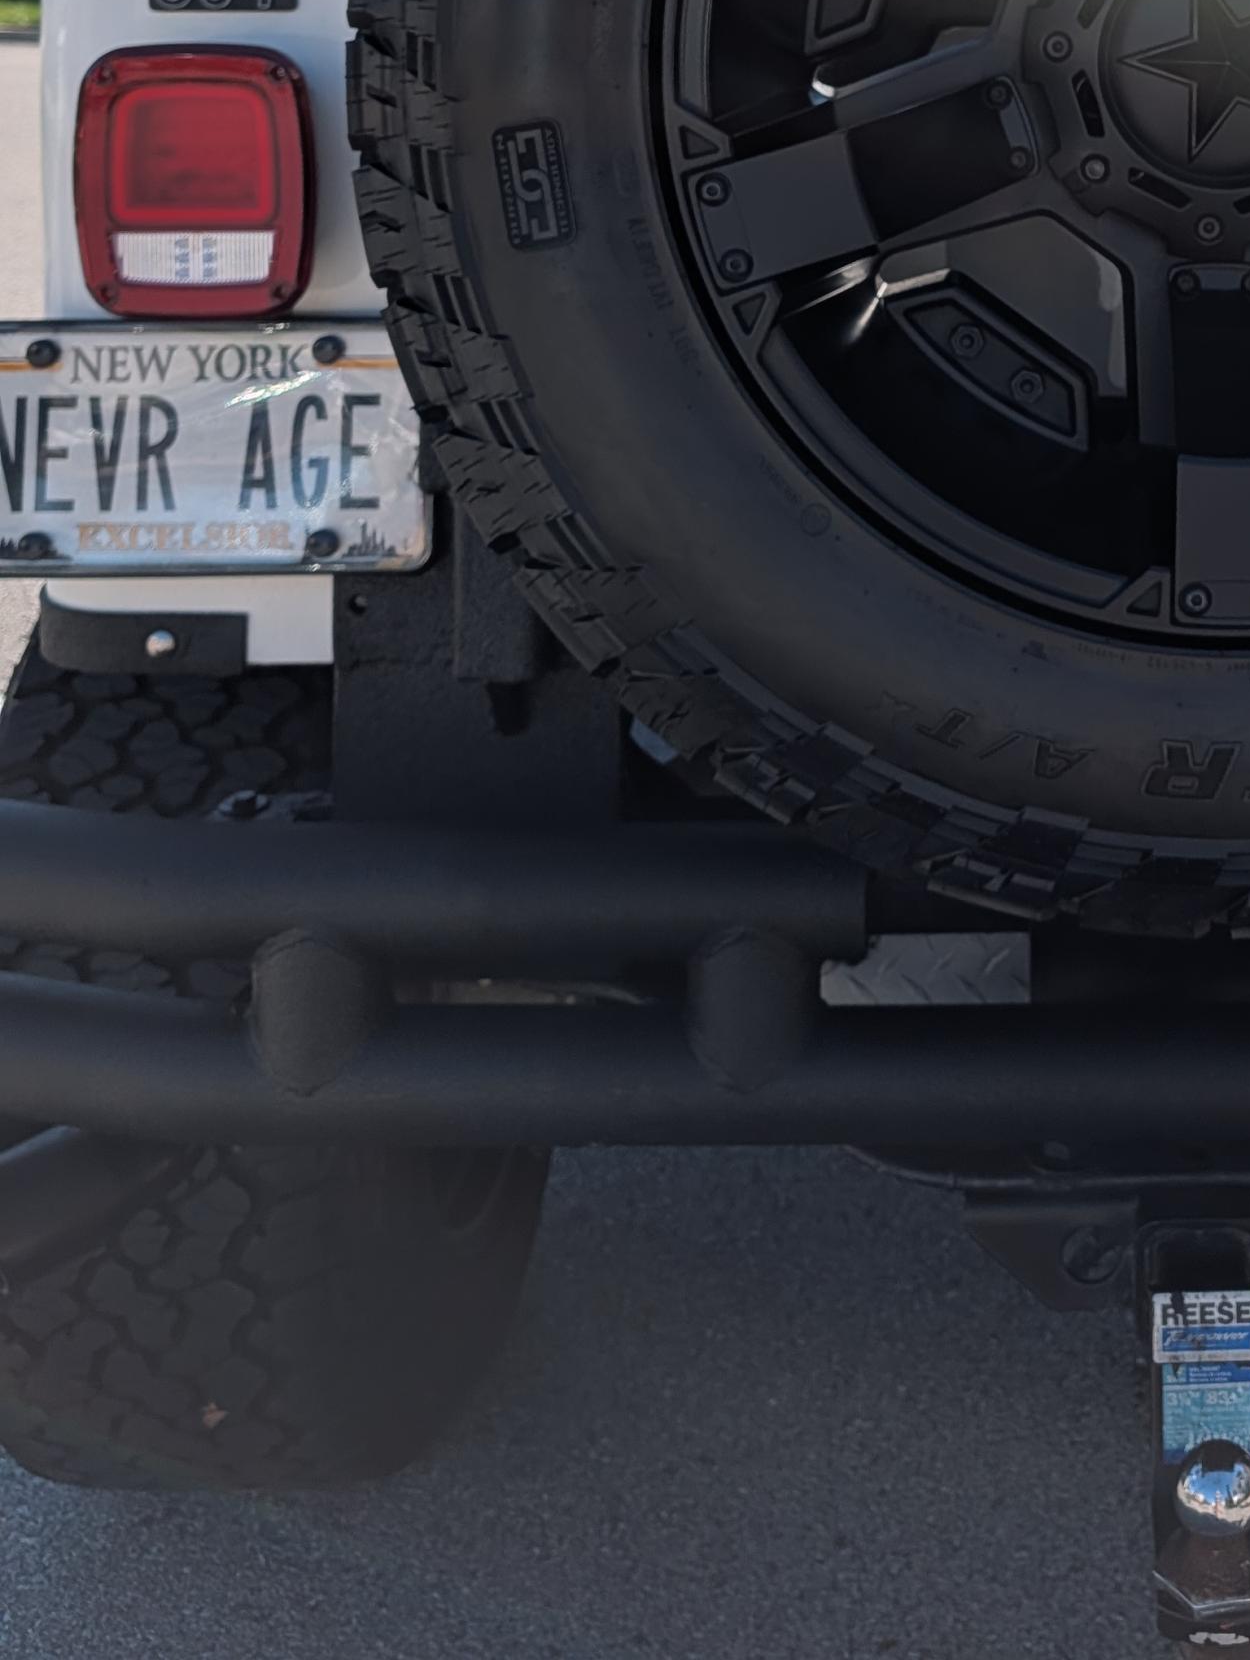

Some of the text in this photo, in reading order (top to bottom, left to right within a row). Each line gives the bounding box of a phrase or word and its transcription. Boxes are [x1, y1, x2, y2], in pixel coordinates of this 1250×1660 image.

[69, 341, 312, 385] NEW YORK
[0, 392, 383, 513] NEVR AGE
[75, 521, 296, 554] EXCELSIOR
